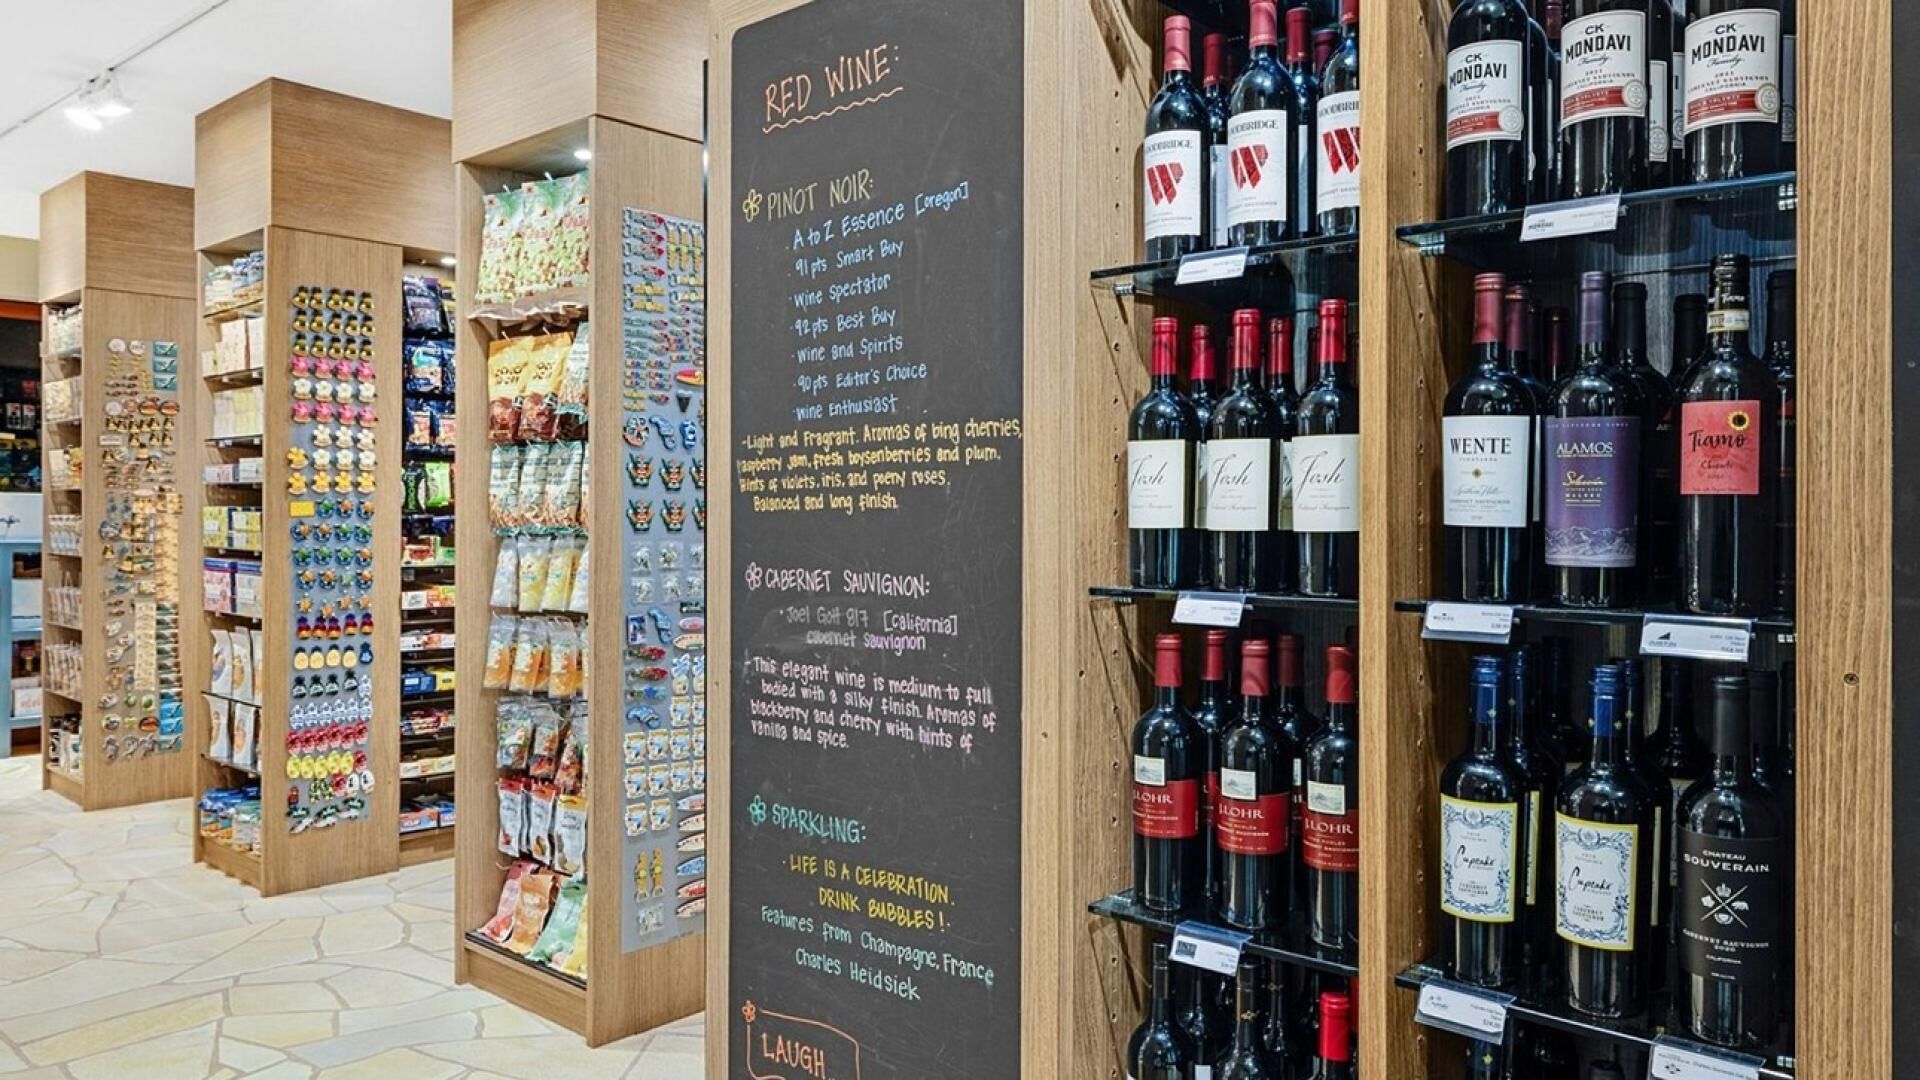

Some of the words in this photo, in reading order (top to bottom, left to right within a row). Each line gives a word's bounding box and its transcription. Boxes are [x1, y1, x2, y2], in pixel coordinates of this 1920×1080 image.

[1585, 23, 1604, 35] CK
[1715, 23, 1736, 35] CK
[1465, 53, 1482, 64] CK
[1565, 33, 1631, 64] MONDAVI
[1692, 34, 1765, 64] MONDAVI
[765, 74, 812, 121] RED
[825, 43, 900, 98] WINE:
[1449, 63, 1507, 90] MONDAVI
[767, 182, 818, 222] PINOT
[830, 168, 874, 207] NOIR:
[793, 229, 803, 250] A
[807, 228, 821, 244] to
[824, 219, 834, 241] Z
[842, 203, 905, 237] Essence
[837, 244, 874, 268] Smart
[880, 239, 904, 257] Buy
[836, 310, 865, 332] Best
[871, 305, 896, 327] Buy
[831, 341, 854, 360] and
[860, 334, 903, 360] Spirits
[836, 368, 880, 388] Editor's
[886, 362, 928, 380] Choice
[829, 393, 898, 416] Enthusiast
[779, 430, 798, 448] and
[863, 424, 910, 442] Aromas
[914, 423, 927, 442] of
[931, 421, 960, 445] bing
[1450, 437, 1512, 455] WENTE
[1556, 441, 1614, 454] ALAMOS
[1688, 429, 1748, 453] Tiamo
[813, 452, 844, 470] fresh
[848, 446, 931, 467] boysenberries
[937, 446, 959, 462] and
[847, 470, 868, 486] and
[753, 494, 800, 512] Balanced
[804, 493, 824, 510] and
[829, 493, 853, 516] long
[765, 568, 832, 592] CABERNET
[843, 570, 930, 599] SAUVIGNON:
[786, 605, 810, 623] Joel
[864, 632, 926, 656] sauvignon
[782, 660, 829, 685] elegant
[835, 666, 866, 689] wine
[873, 672, 885, 692] is
[888, 675, 942, 701] medium
[965, 686, 993, 706] full
[761, 678, 796, 698] bodied
[800, 683, 825, 702] with
[829, 689, 838, 705] a
[844, 691, 874, 713] silky
[926, 703, 976, 727] Aromas
[982, 712, 997, 733] of
[750, 698, 809, 724] blackberry
[812, 708, 835, 726] and
[840, 709, 881, 736] cherry
[885, 719, 914, 741] with
[919, 725, 953, 748] hints
[960, 733, 973, 754] of
[792, 725, 812, 742] and
[817, 729, 850, 749] spice.
[772, 803, 867, 844] SPARKLING:
[789, 854, 817, 875] LIFE
[824, 859, 836, 878] IS
[841, 863, 850, 881] A
[1454, 844, 1496, 869] Cupcake
[1684, 853, 1770, 873] SOUVERAIN
[1702, 849, 1746, 861] CHATEAU
[1568, 866, 1614, 892] Cupcake
[818, 887, 860, 912] DRINK
[762, 905, 815, 933] Features
[822, 921, 852, 944] from
[860, 931, 940, 971] Champagne,
[943, 953, 994, 985] France
[795, 948, 841, 975] Charles
[850, 962, 920, 1000] Heidsiek
[762, 1032, 826, 1079] LAUGH
